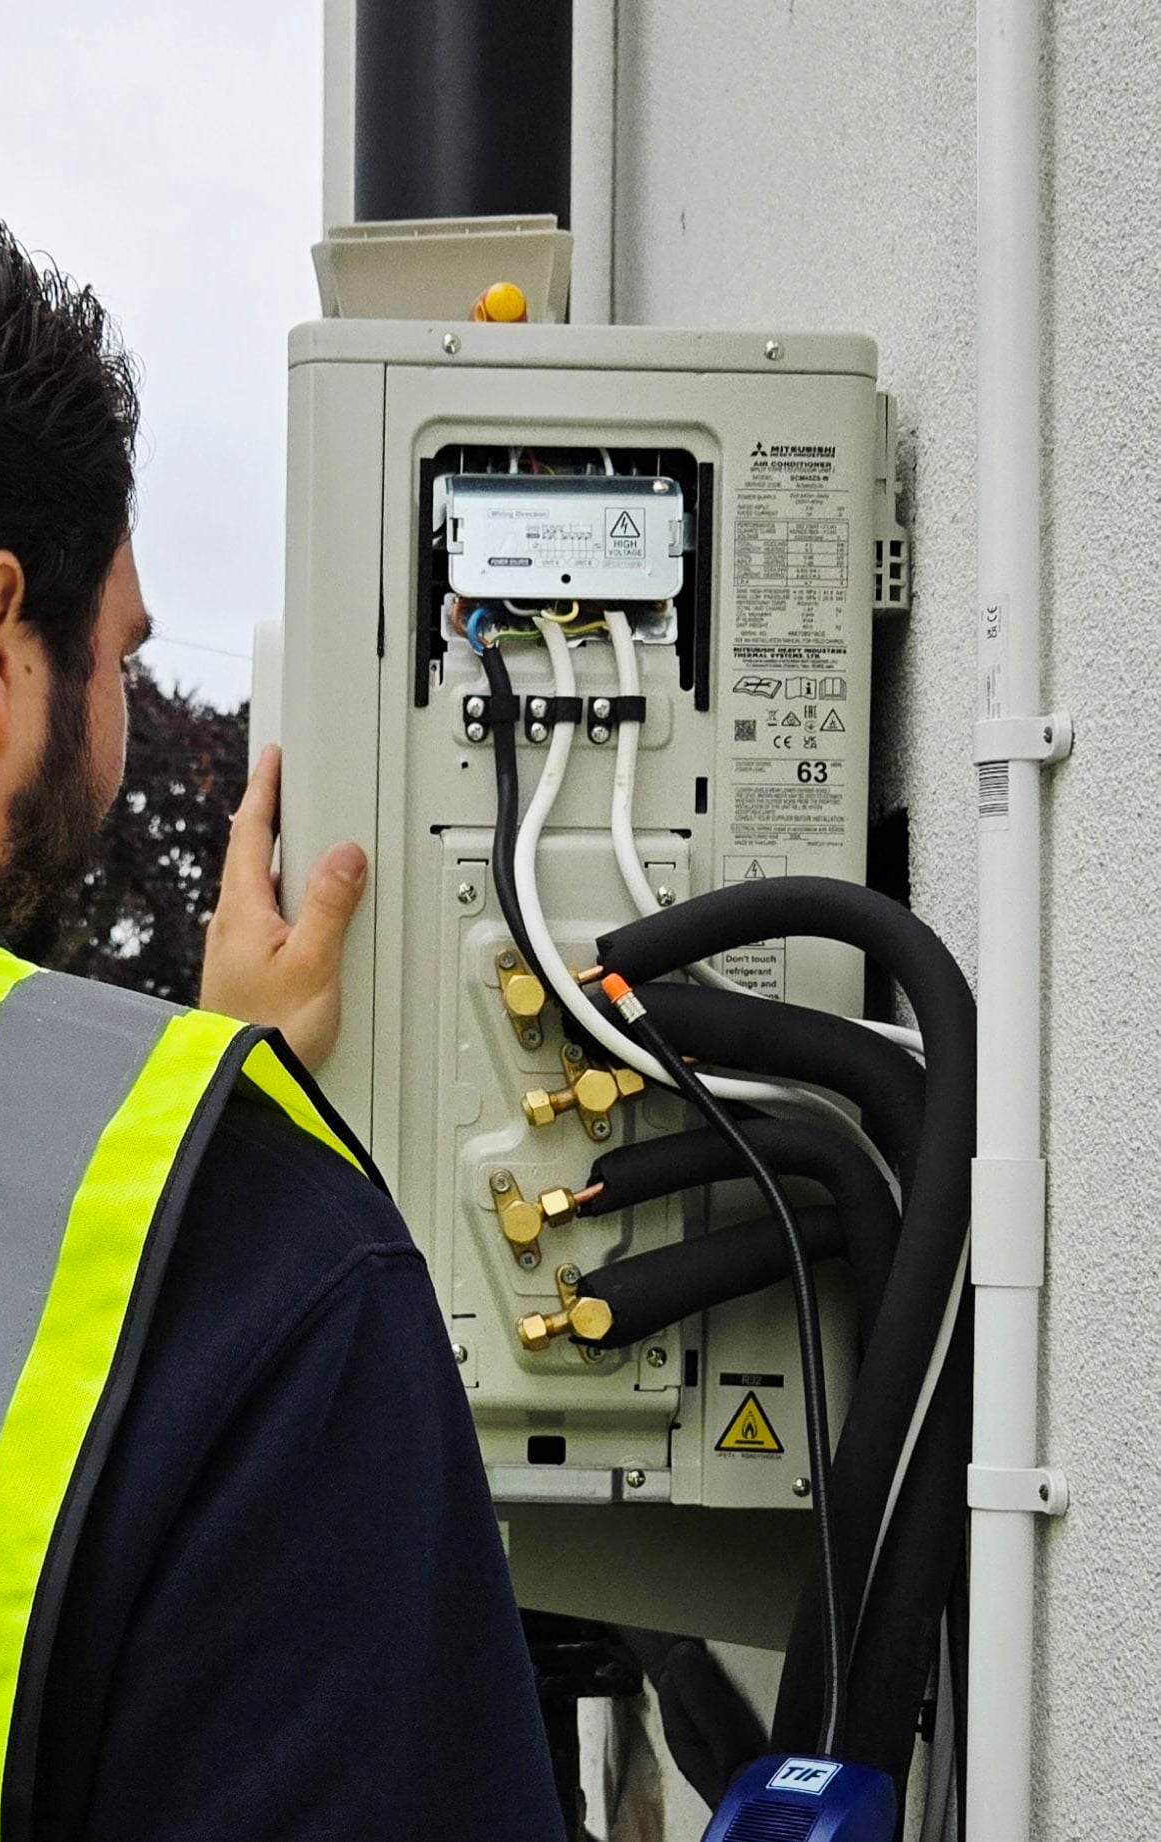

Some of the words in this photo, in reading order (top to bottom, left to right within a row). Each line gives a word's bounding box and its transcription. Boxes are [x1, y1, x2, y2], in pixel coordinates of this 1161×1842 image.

[491, 511, 514, 519] Wiring
[613, 540, 637, 548] HIGH
[608, 549, 642, 557] VOLTAGE
[797, 761, 828, 783] 63
[726, 955, 749, 963] Don't
[751, 955, 776, 963] touch
[726, 968, 771, 976] refrigerant
[760, 980, 776, 988] and
[742, 1375, 762, 1384] R32
[780, 1766, 828, 1782] TIF
